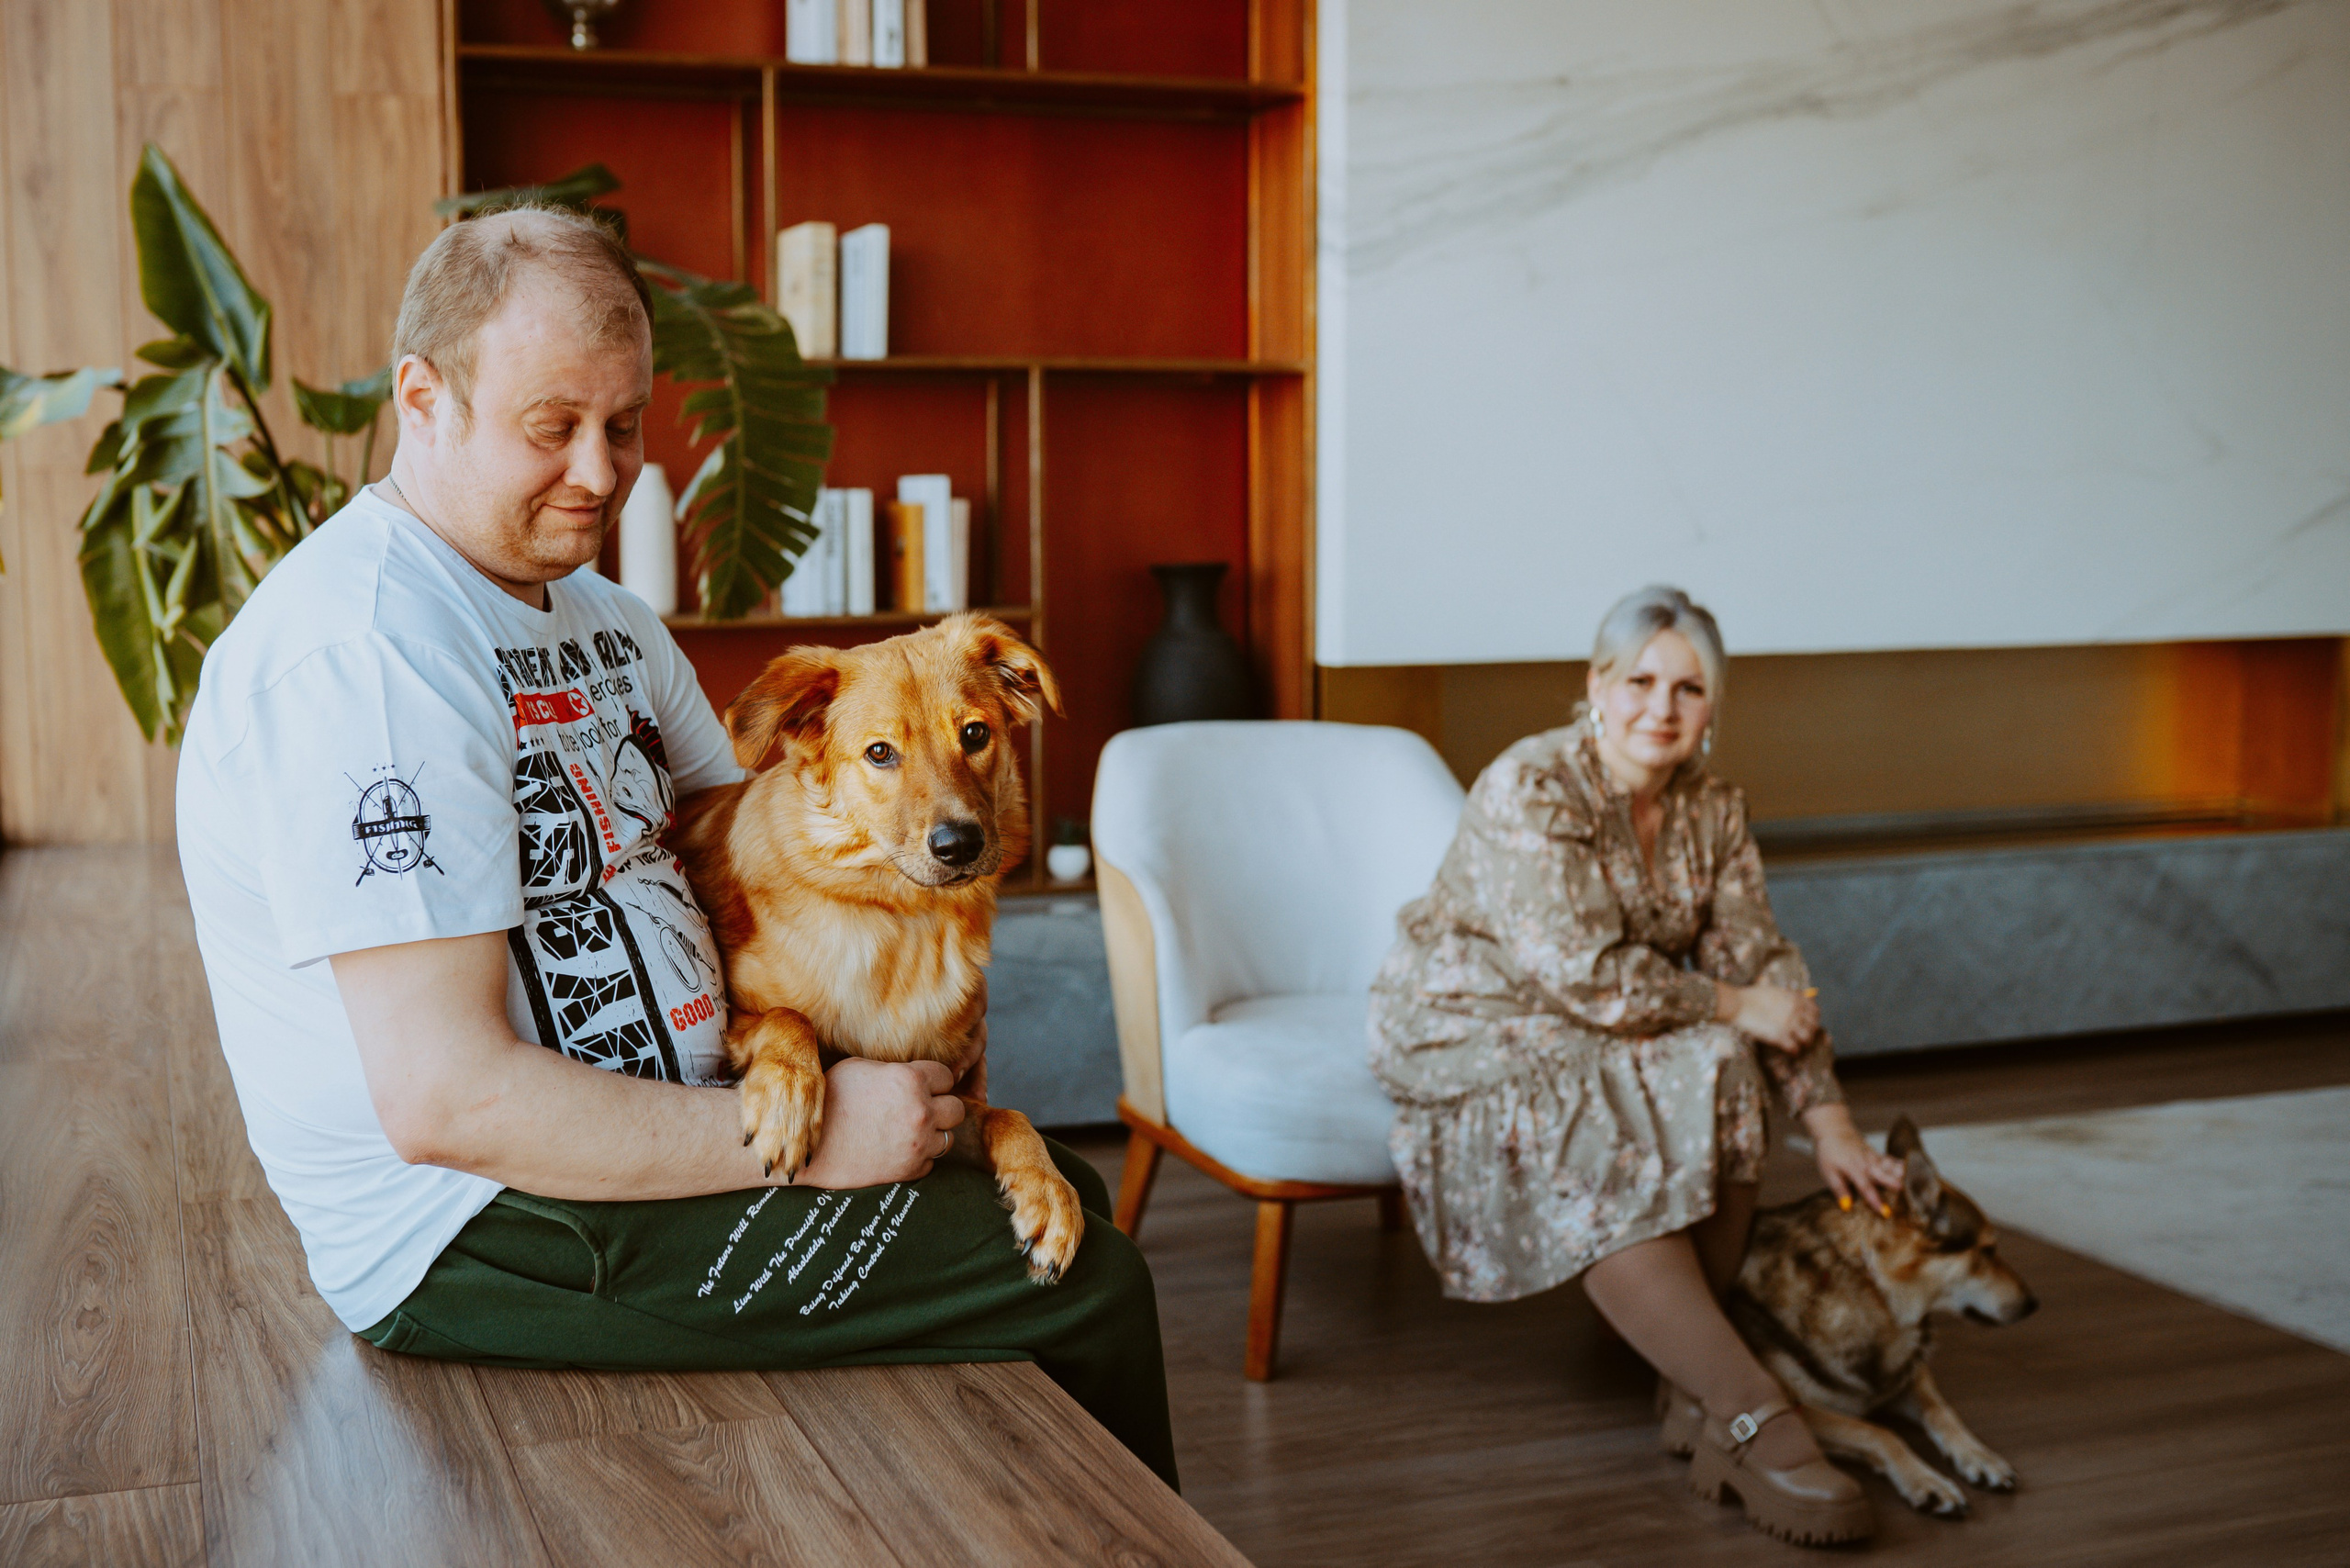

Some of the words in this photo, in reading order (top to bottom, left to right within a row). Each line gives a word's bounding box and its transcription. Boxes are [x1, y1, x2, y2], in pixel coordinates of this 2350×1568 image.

[364, 820, 419, 834] FISHING
[569, 763, 622, 854] FISHING
[669, 993, 715, 1032] GOOD
[698, 1279, 715, 1298] The
[708, 1244, 733, 1279] Future
[729, 1217, 750, 1243] Will
[746, 1186, 778, 1219] Remain
[733, 1291, 753, 1315] Live
[749, 1267, 773, 1293] With
[768, 1251, 788, 1268] The
[784, 1207, 820, 1251] Principle
[816, 1193, 833, 1206] Of
[788, 1236, 826, 1285] Absolutely
[820, 1195, 854, 1237] Fearless.
[799, 1292, 826, 1316] Being
[822, 1252, 855, 1291] Defined
[850, 1238, 867, 1254] By
[860, 1215, 881, 1238] Your
[828, 1280, 860, 1310] Taking
[857, 1241, 886, 1280] Control
[881, 1226, 898, 1243] Of
